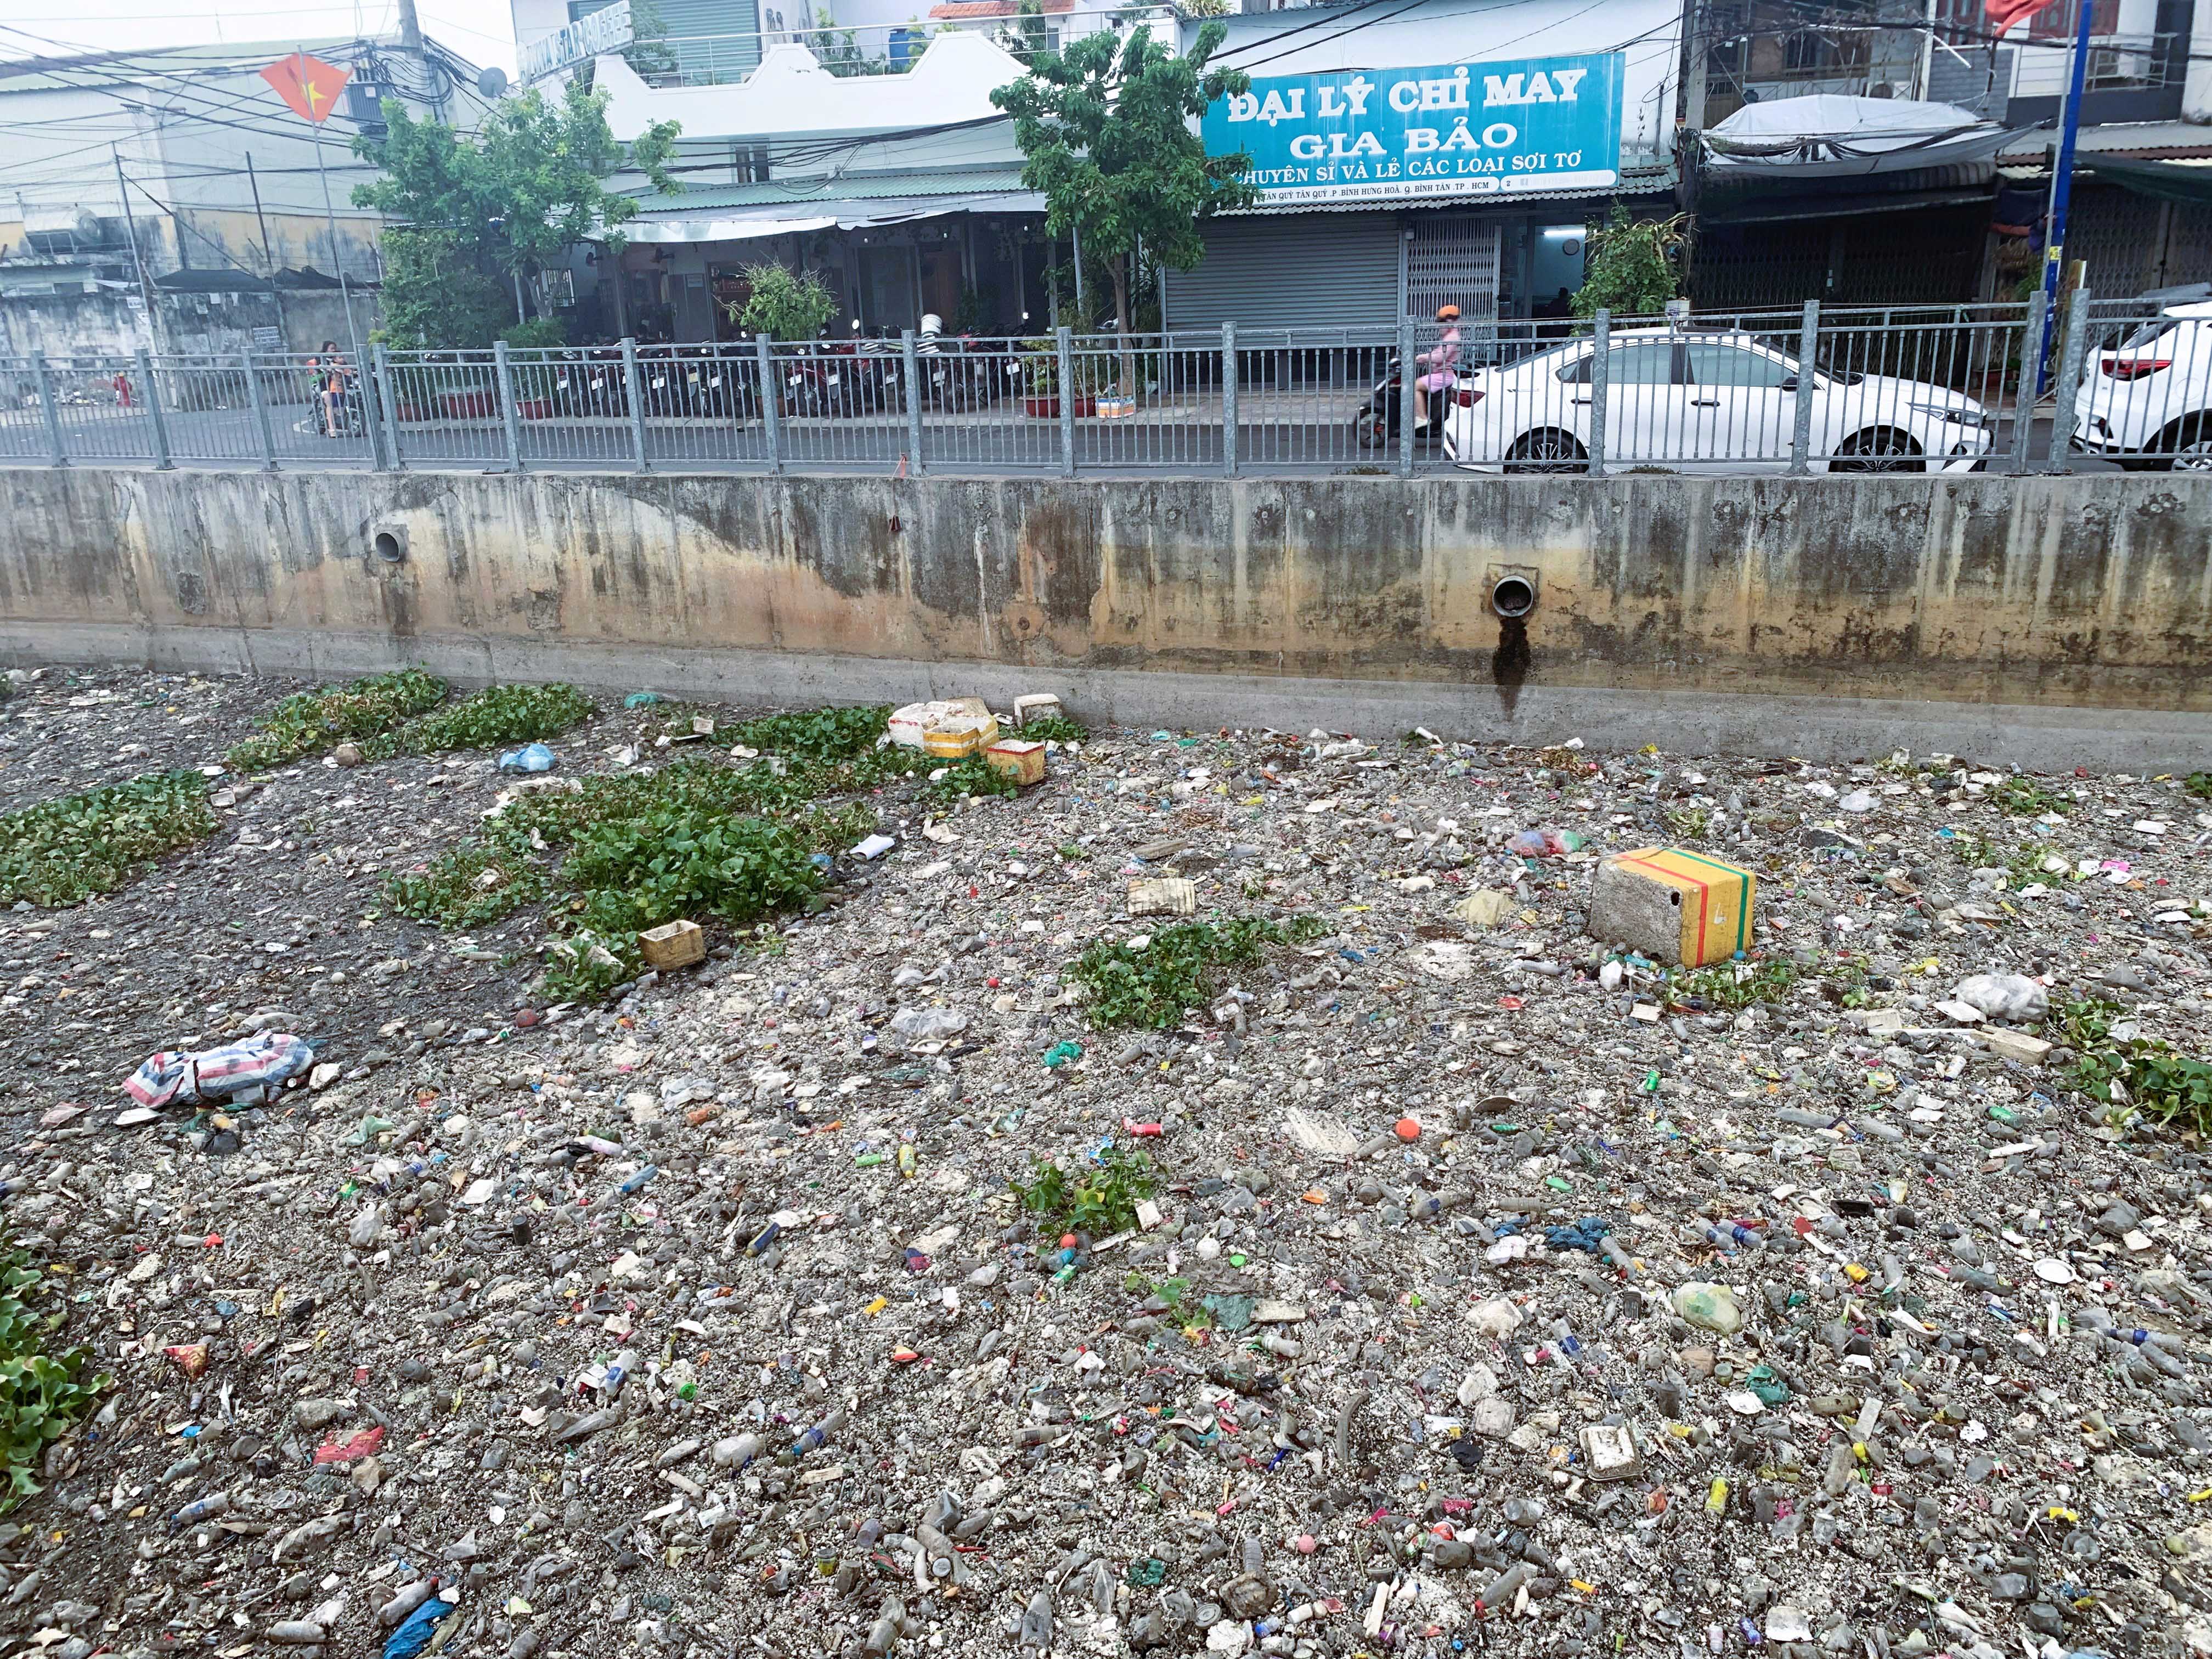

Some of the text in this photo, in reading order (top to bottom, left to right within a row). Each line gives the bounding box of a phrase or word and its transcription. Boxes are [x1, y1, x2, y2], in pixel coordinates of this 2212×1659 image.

[583, 0, 633, 55] COFFEE
[1227, 65, 1588, 127] ĐẠI LÝ CHỈ MAY
[1290, 116, 1518, 160] GIA BẢO
[1317, 161, 1335, 182] SỈ
[1341, 160, 1369, 179] VÀ
[1375, 156, 1401, 178] LẺ
[1408, 156, 1450, 176] CÁC
[1457, 156, 1505, 175] LOẠI
[1512, 152, 1547, 172] SỢI
[1554, 149, 1582, 167] TƠ
[1472, 181, 1489, 189] HCM
